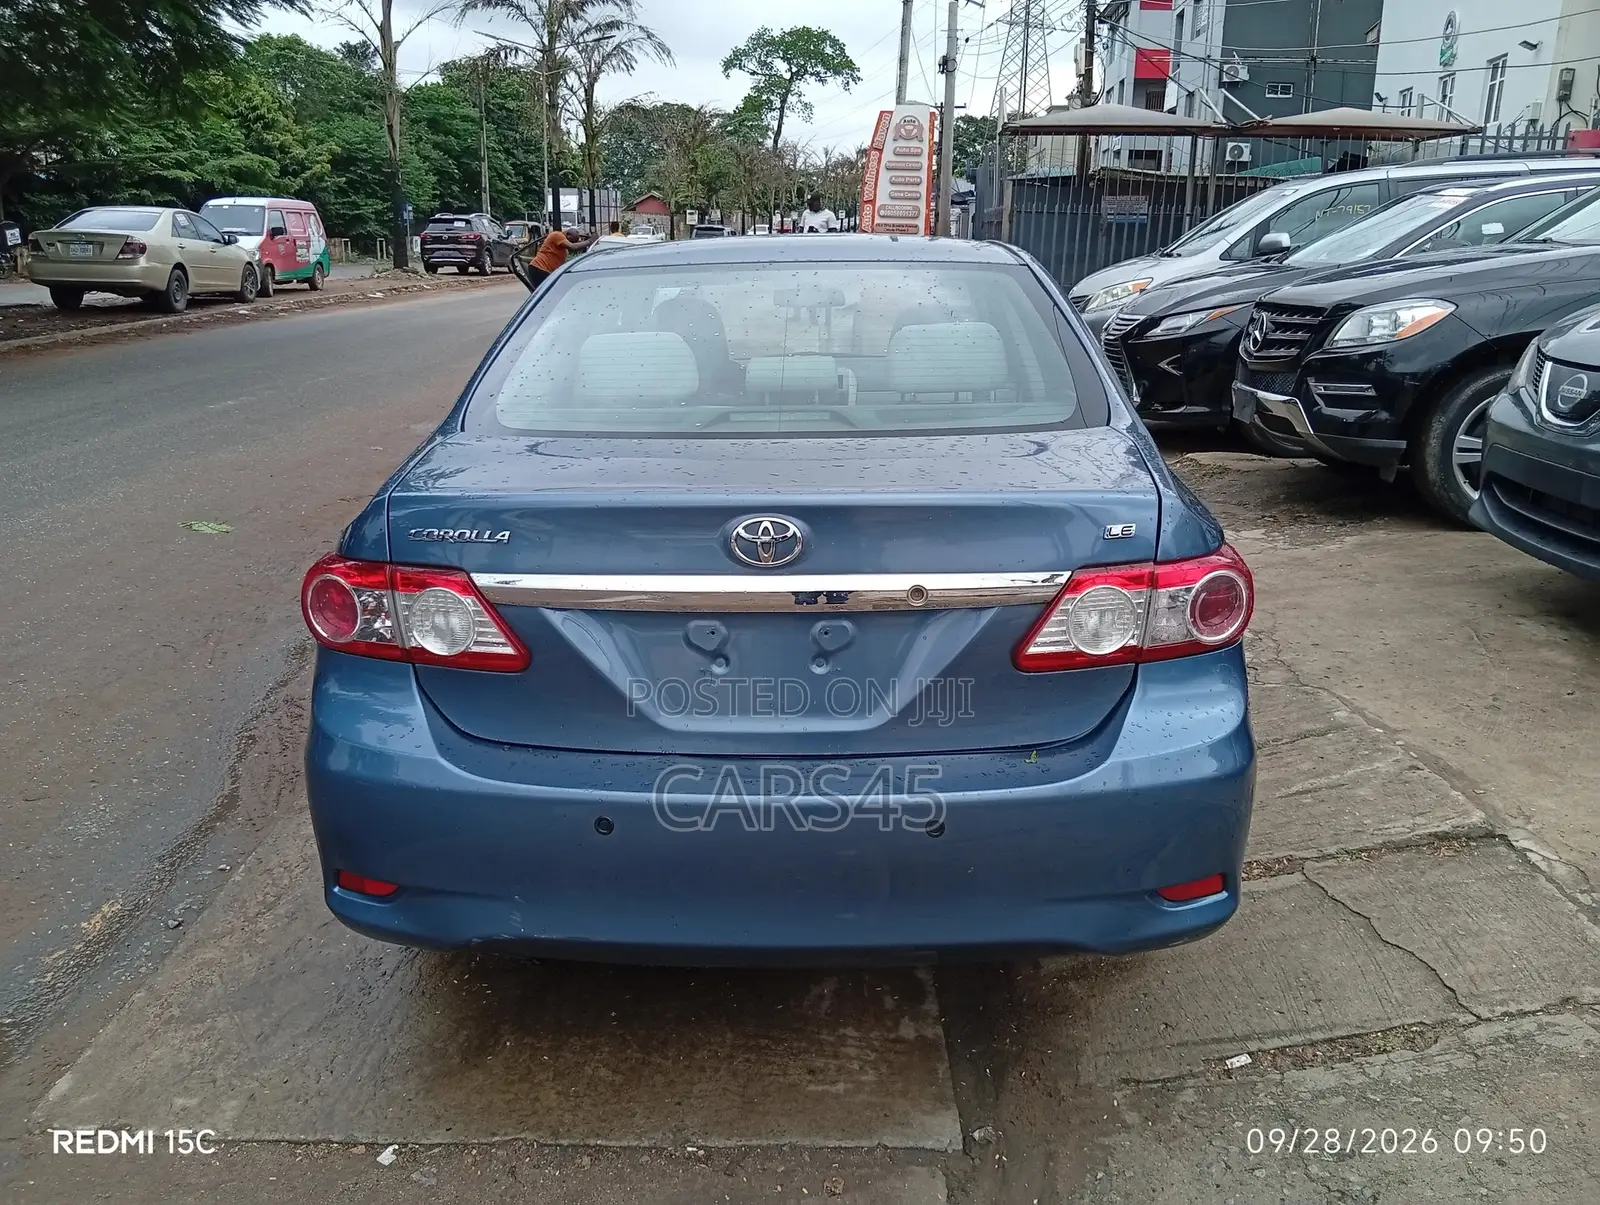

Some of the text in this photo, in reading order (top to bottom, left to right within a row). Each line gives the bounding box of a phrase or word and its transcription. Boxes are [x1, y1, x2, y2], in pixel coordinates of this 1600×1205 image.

[861, 113, 891, 233] Auto Wellness Haven
[1559, 386, 1585, 397] NISSAN
[408, 527, 511, 545] COROLLA
[1106, 525, 1134, 538] LE
